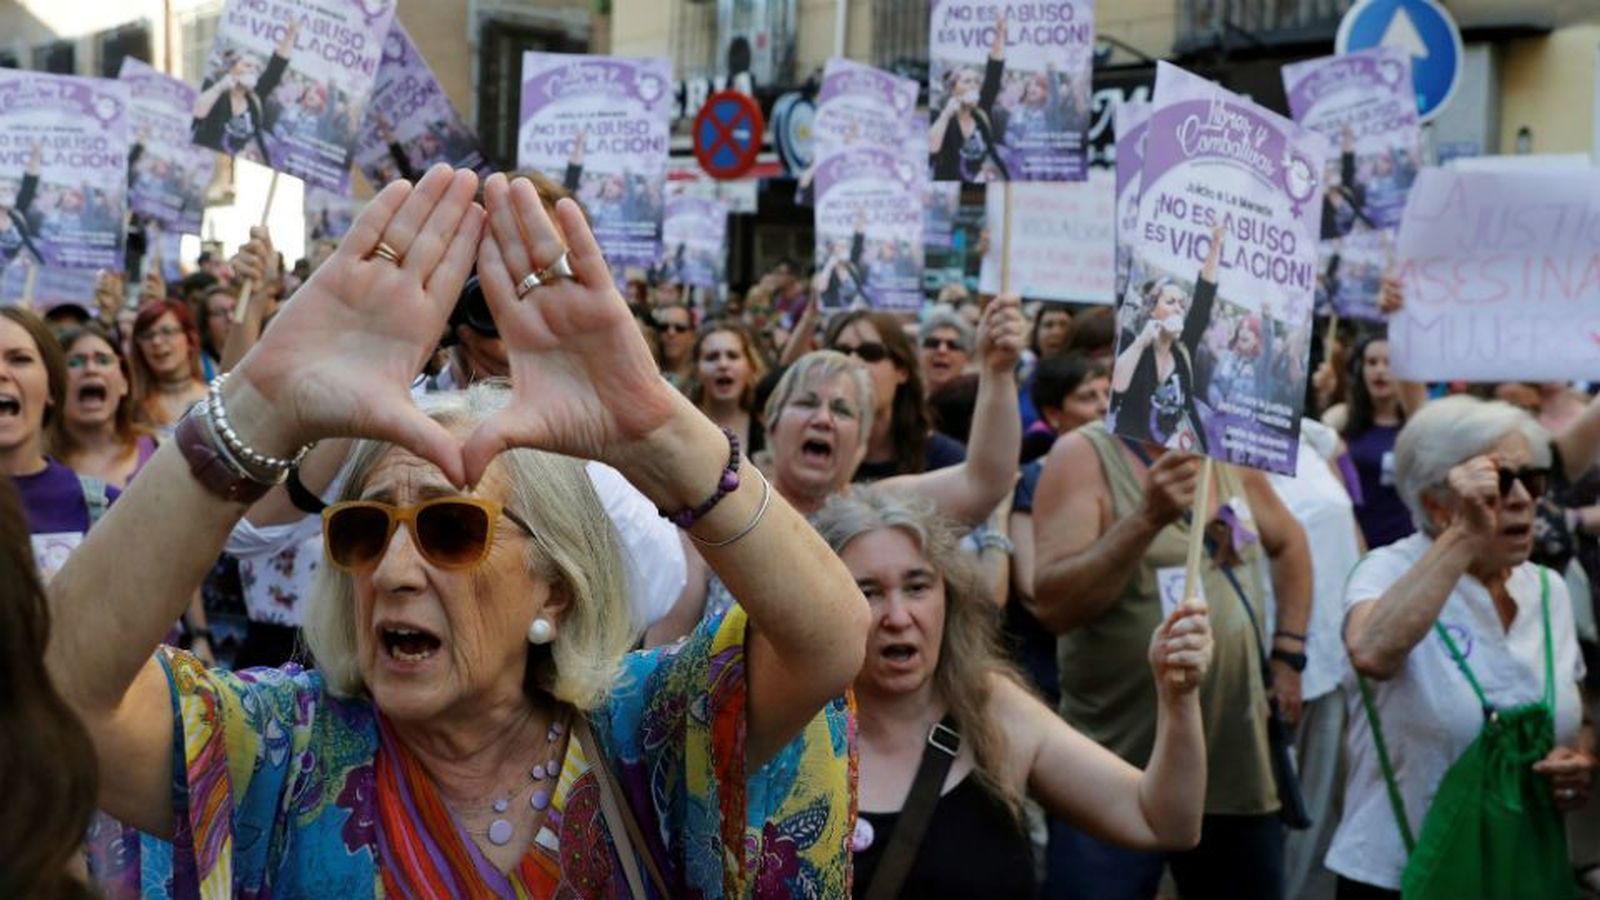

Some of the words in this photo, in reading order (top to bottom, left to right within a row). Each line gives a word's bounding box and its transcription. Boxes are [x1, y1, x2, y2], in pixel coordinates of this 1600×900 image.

[1004, 2, 1074, 22] ABUSO
[299, 12, 365, 50] ABUSO
[584, 119, 650, 136] ABUSO
[1144, 221, 1167, 243] ES
[1154, 193, 1188, 220] ¡NO
[1192, 204, 1217, 228] ES
[1223, 212, 1297, 256] ABUSO
